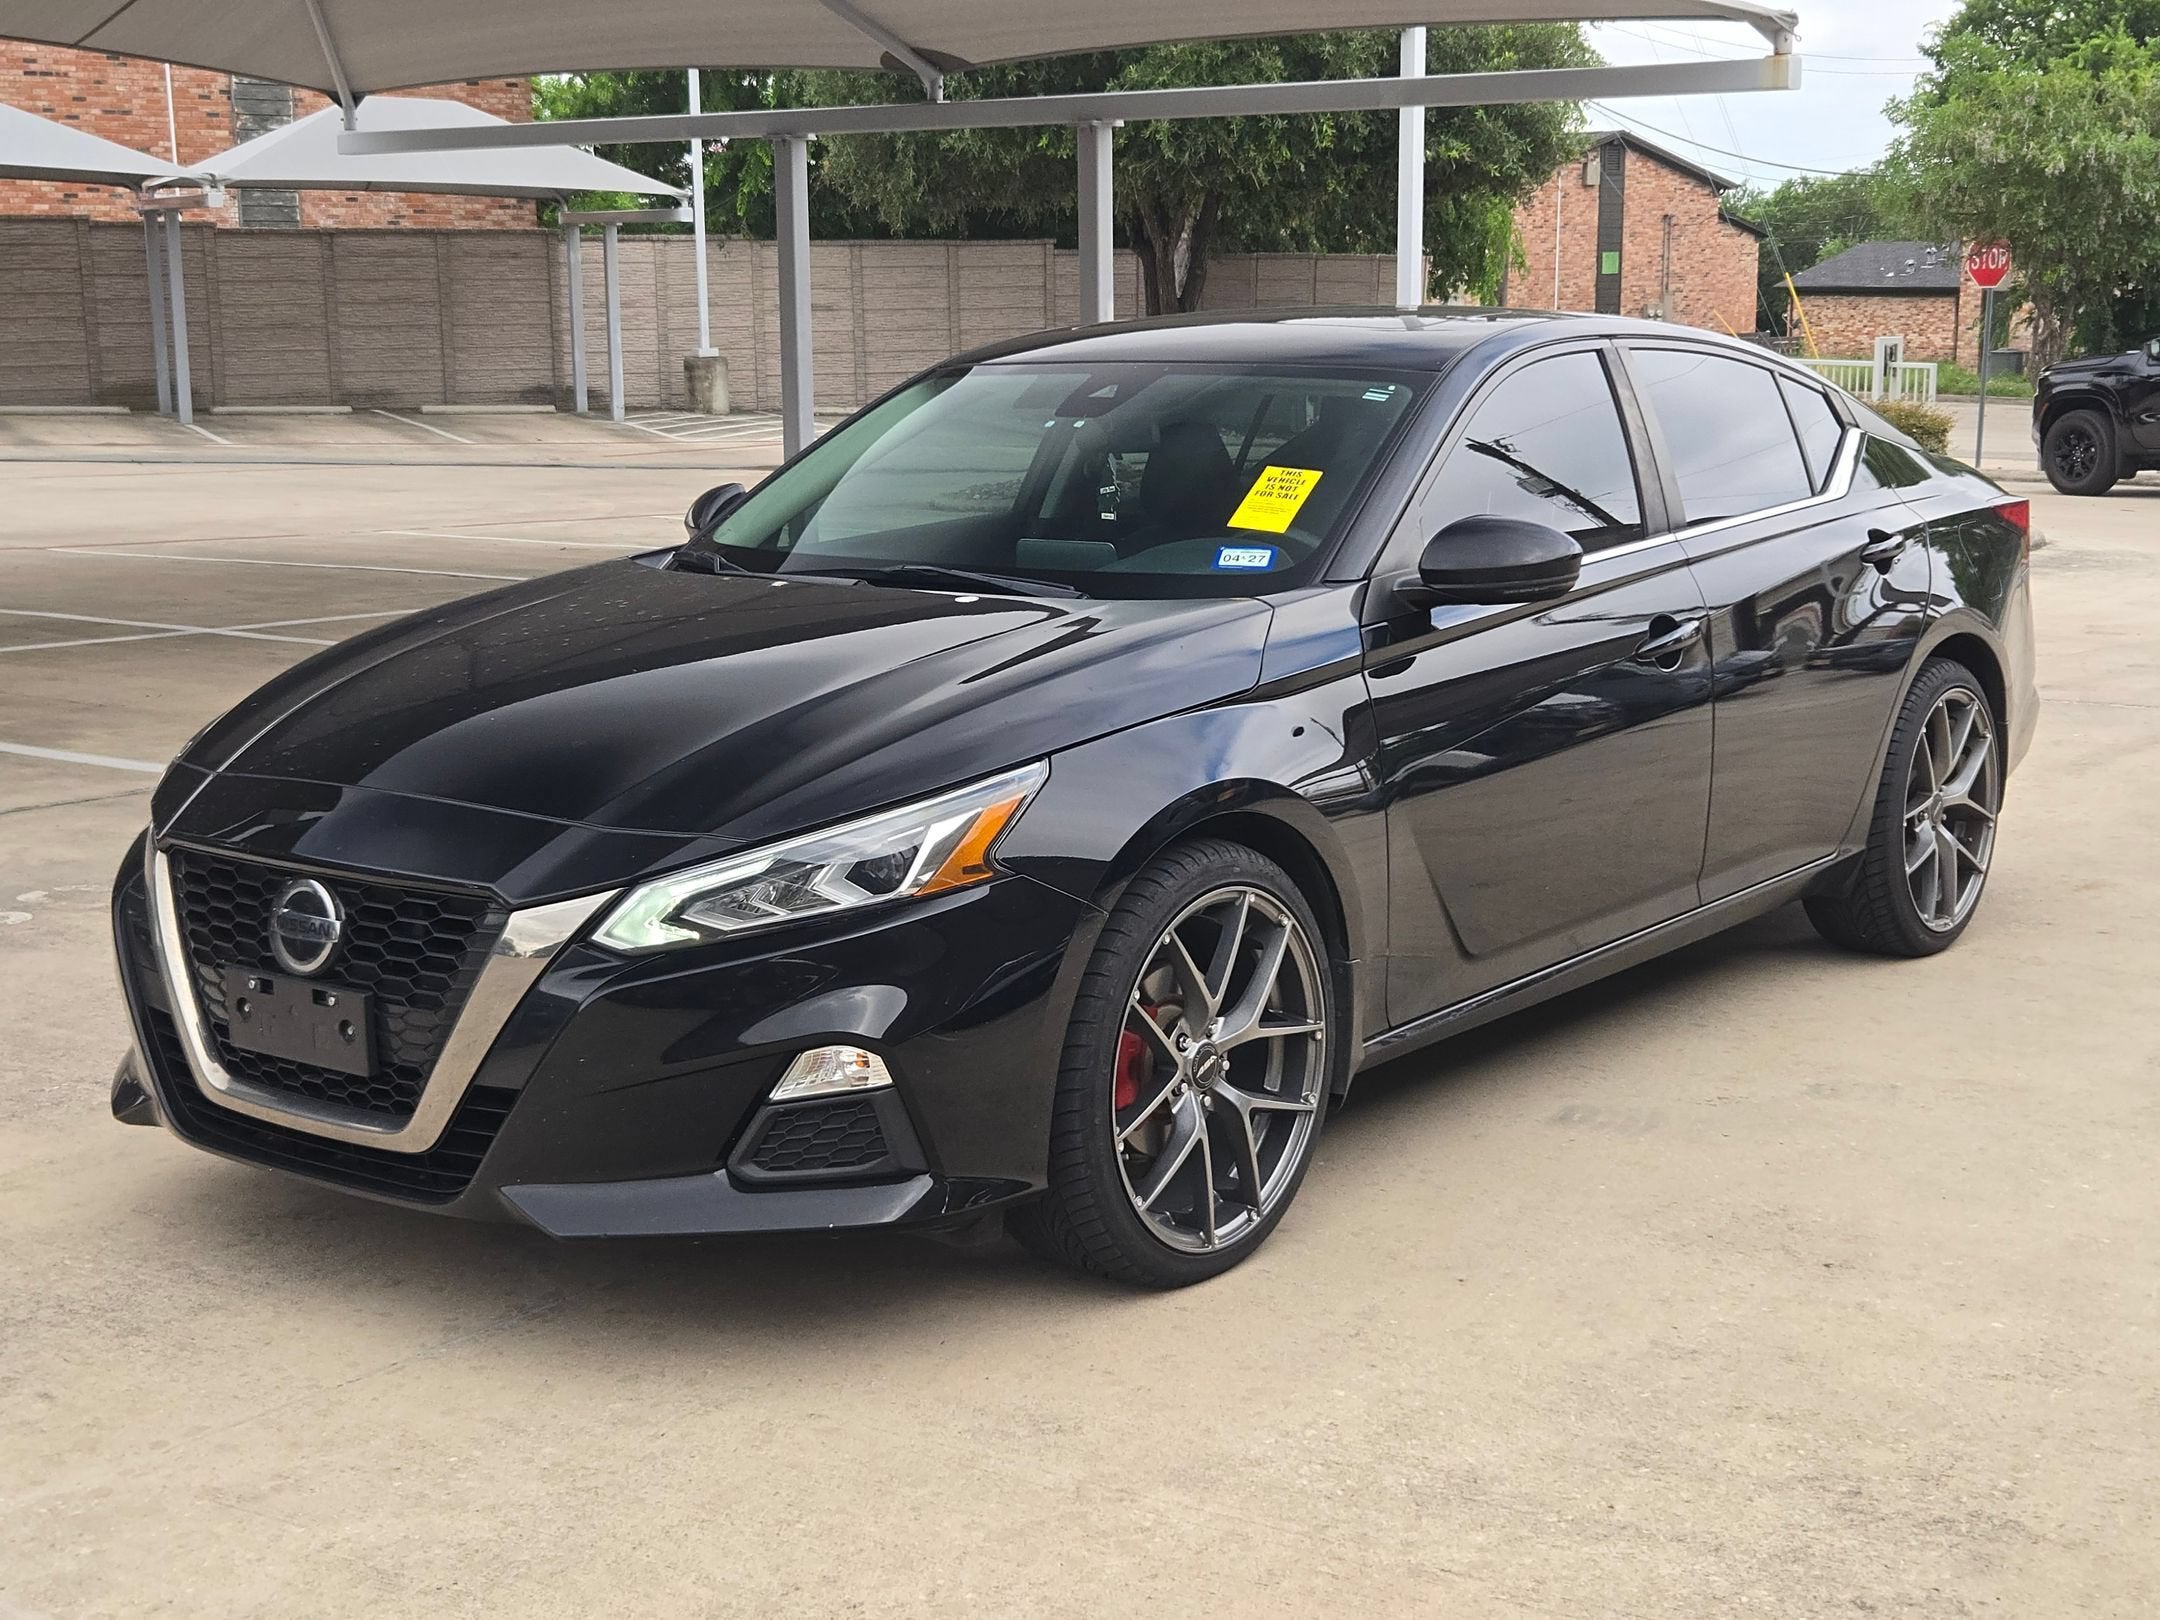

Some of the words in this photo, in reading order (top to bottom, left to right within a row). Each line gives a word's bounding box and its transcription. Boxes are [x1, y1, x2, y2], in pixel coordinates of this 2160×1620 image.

[1970, 248, 2008, 269] STOP
[1267, 476, 1306, 485] VEHICLE
[1275, 492, 1299, 500] SALE
